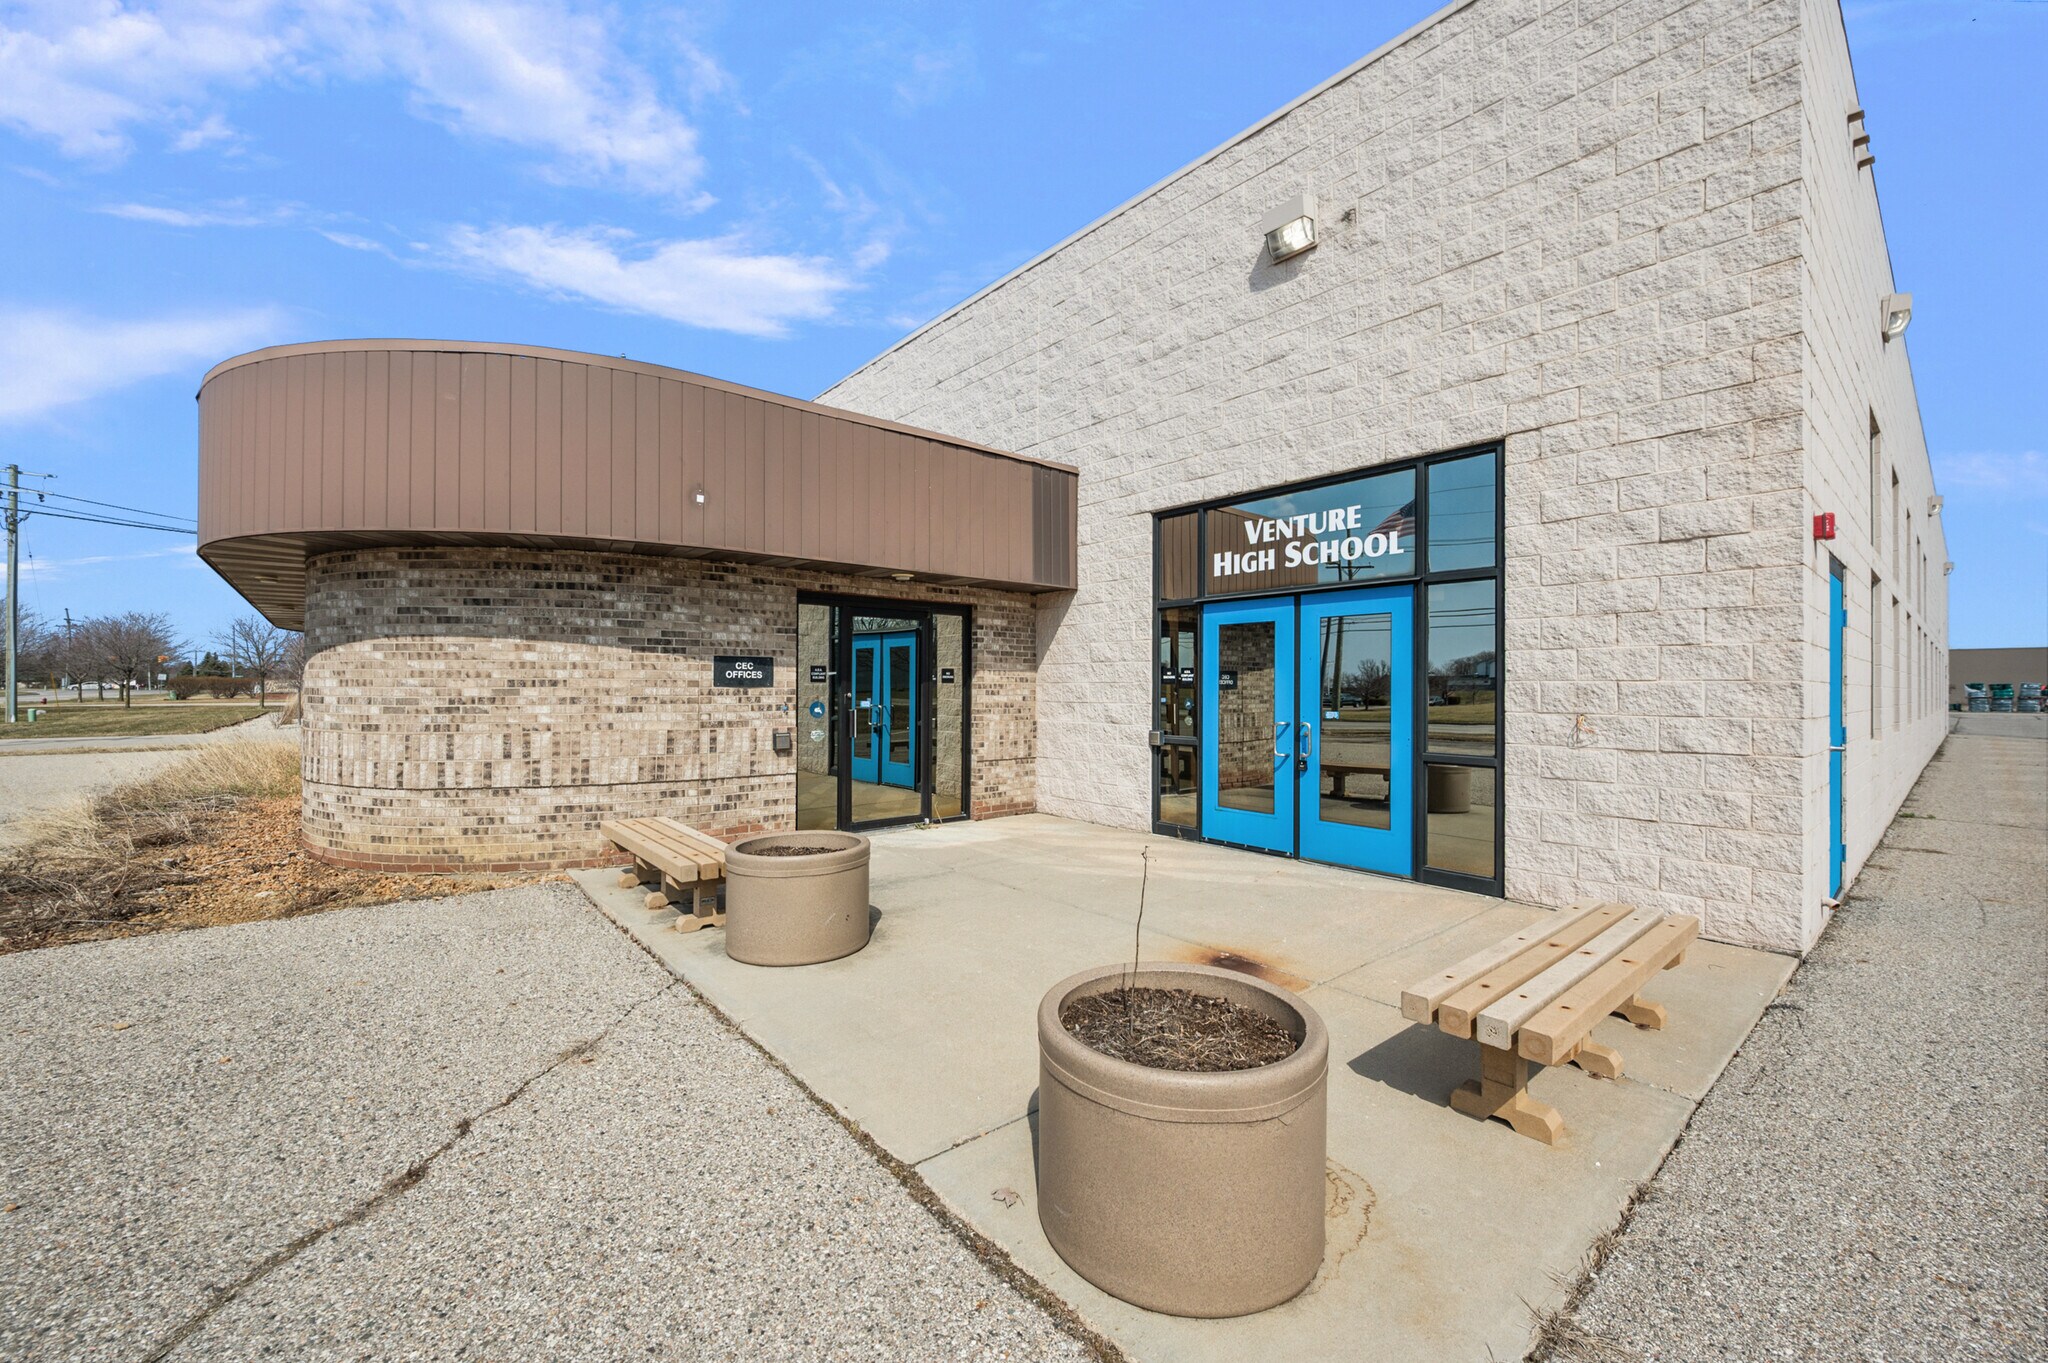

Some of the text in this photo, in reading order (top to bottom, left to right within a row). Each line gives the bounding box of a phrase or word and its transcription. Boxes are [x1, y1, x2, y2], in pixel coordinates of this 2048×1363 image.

[1244, 504, 1361, 545] VENTURE
[1213, 530, 1404, 577] HIGH SCHOOL
[725, 670, 763, 679] OFFICES
[735, 662, 754, 670] CEC
